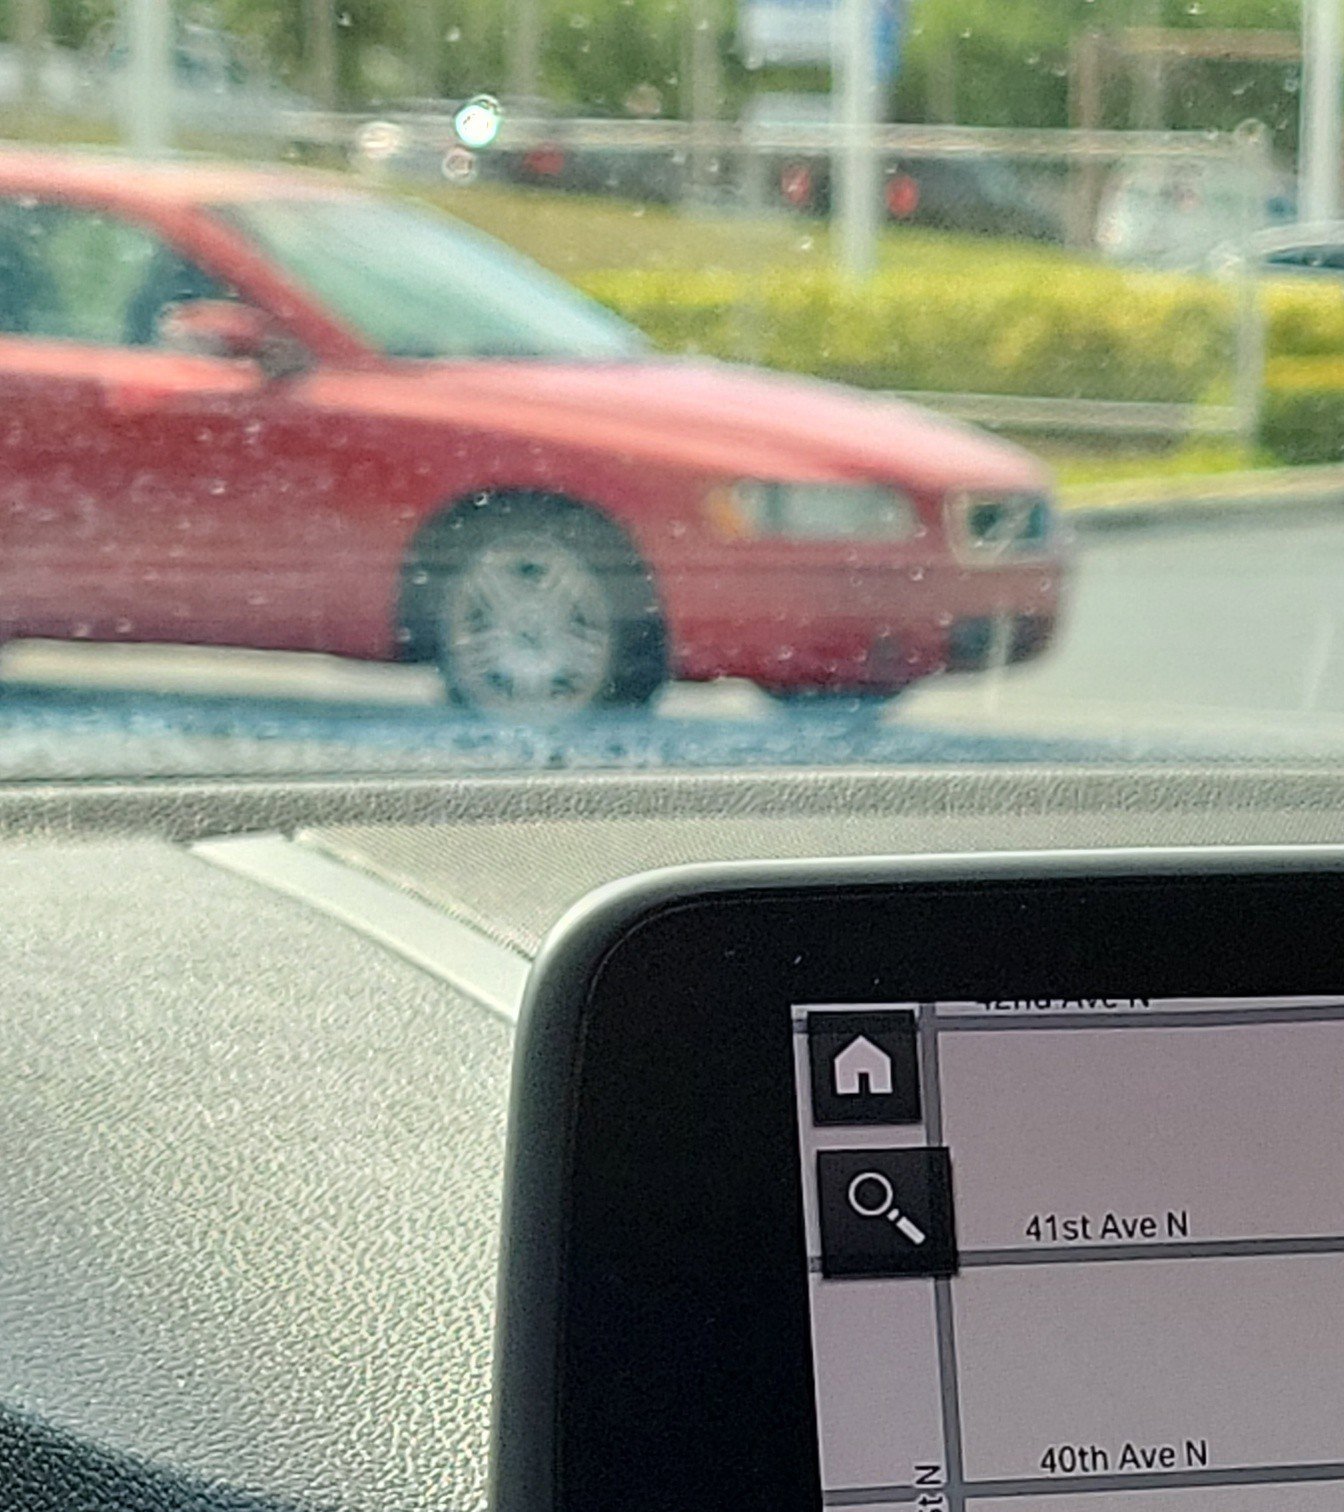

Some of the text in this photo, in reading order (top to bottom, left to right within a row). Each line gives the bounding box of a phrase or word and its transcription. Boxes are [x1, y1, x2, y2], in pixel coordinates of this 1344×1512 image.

[1026, 1211, 1188, 1241] 41st Ave N
[1040, 1440, 1208, 1472] 40th Ave N
[914, 1465, 941, 1485] N
